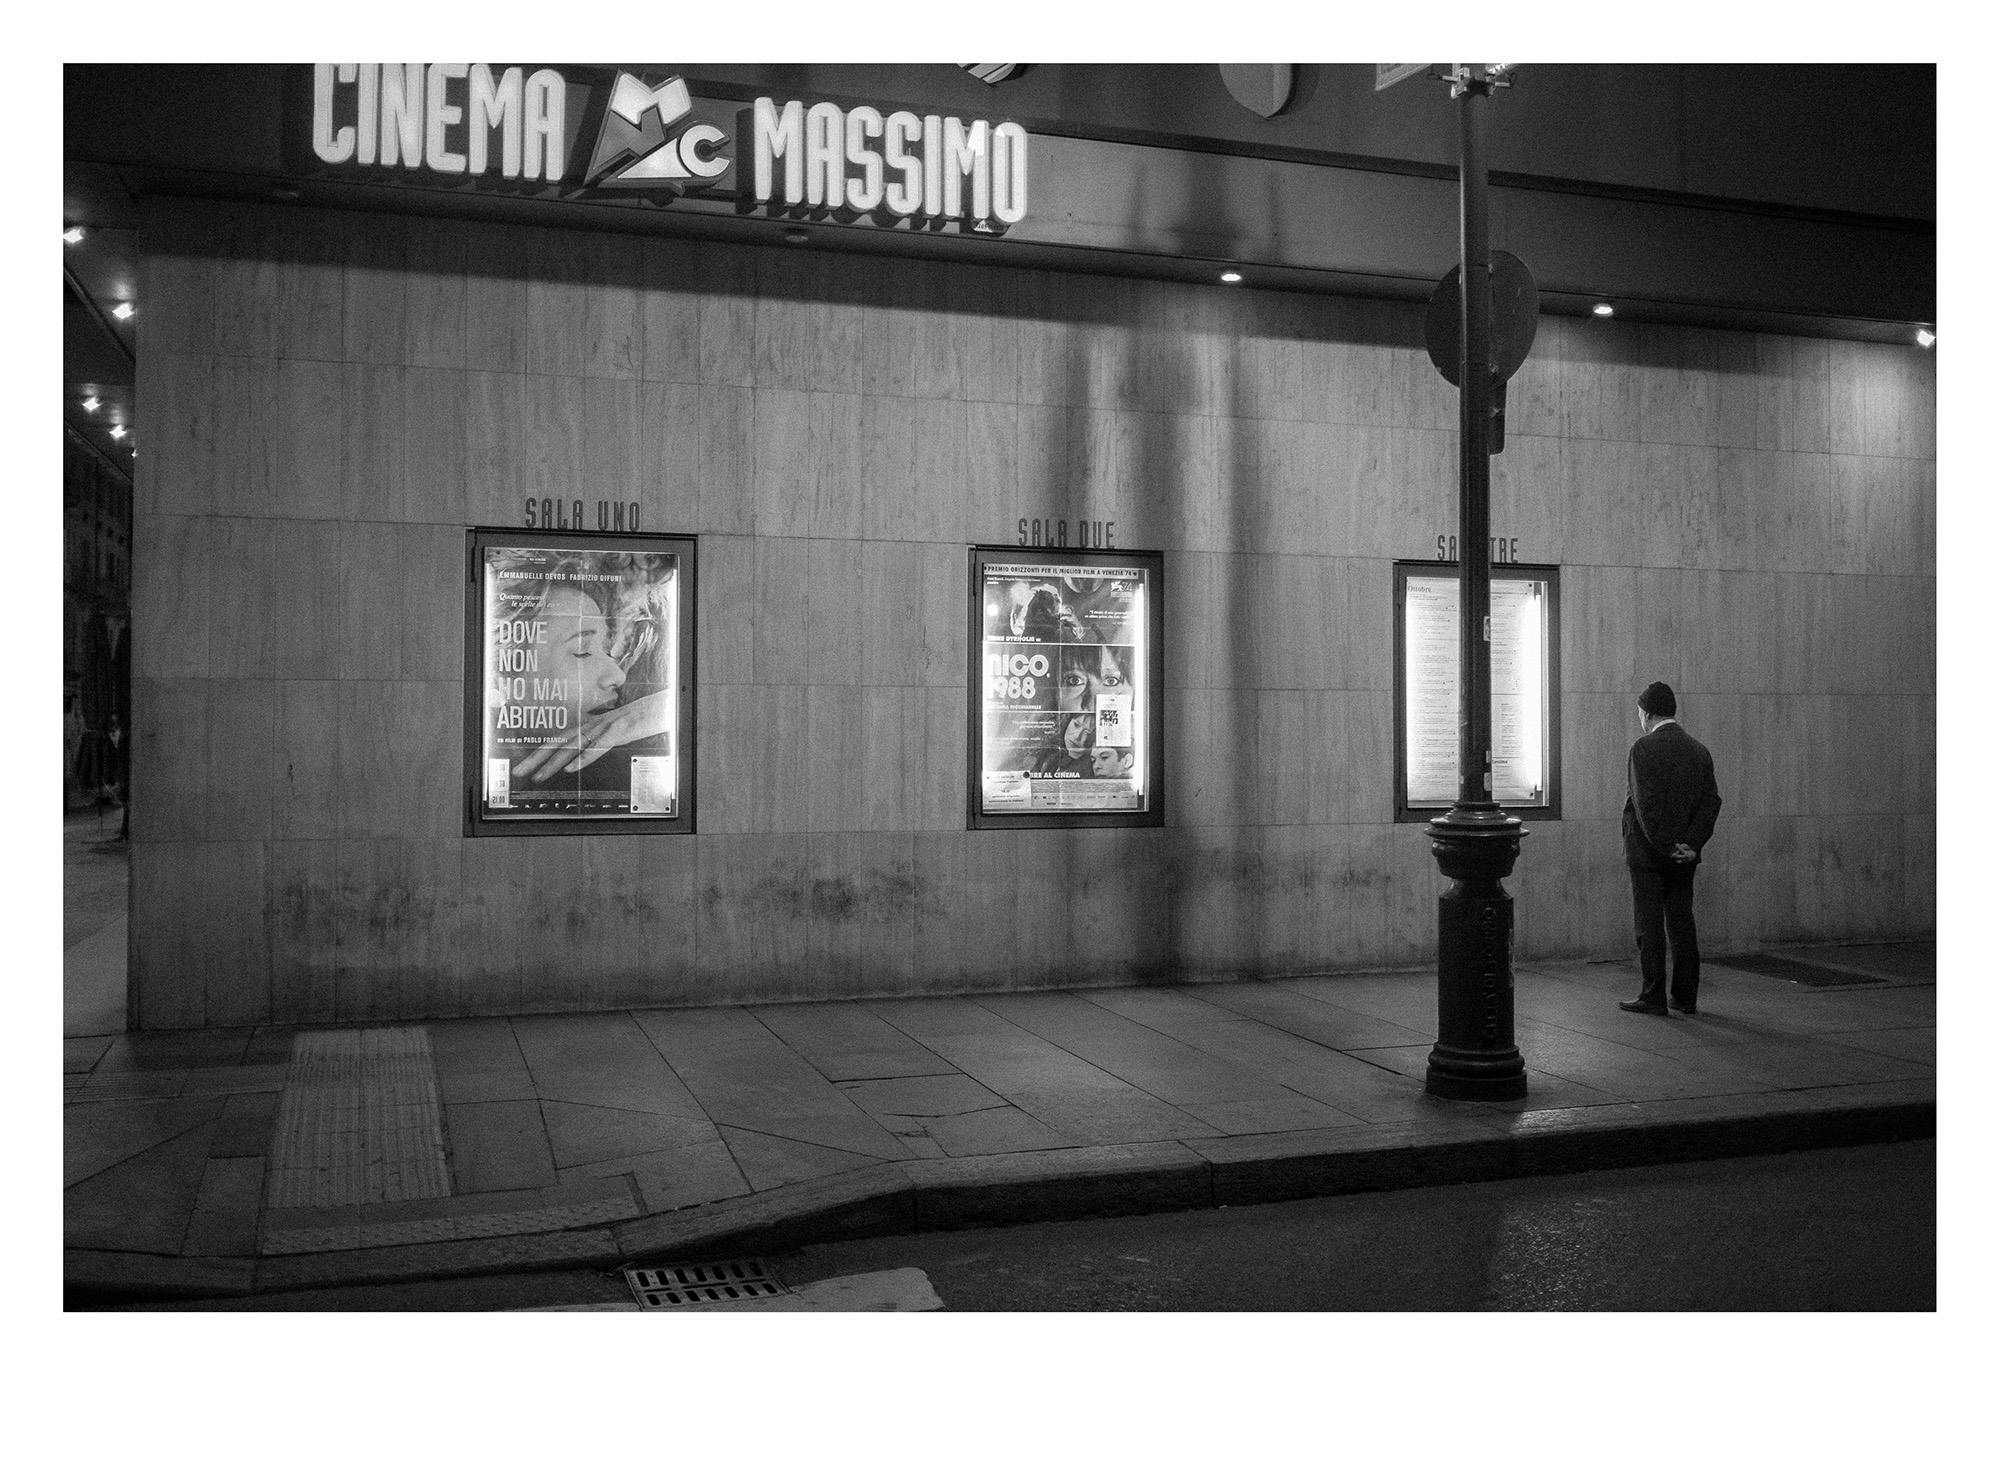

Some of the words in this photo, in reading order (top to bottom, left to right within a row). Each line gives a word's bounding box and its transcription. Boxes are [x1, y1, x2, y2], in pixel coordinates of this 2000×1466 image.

[312, 63, 567, 182] CINEMA
[753, 97, 1028, 223] MASSIMO
[525, 497, 584, 530] SALA
[597, 500, 640, 532] UNO
[1018, 517, 1068, 548] SALA
[1079, 520, 1115, 549] DUE
[1488, 536, 1519, 564] TRE
[499, 571, 544, 580] EMMANUELLE
[544, 572, 566, 581] DEVOS
[569, 573, 598, 582] FABRIZIO
[498, 620, 548, 644] DOVE
[498, 649, 538, 672] NON
[498, 676, 526, 701] HO
[533, 677, 568, 701] MAI
[496, 705, 568, 730] ABITATO
[523, 736, 542, 744] PAOLO
[1053, 771, 1081, 779] CINEMA
